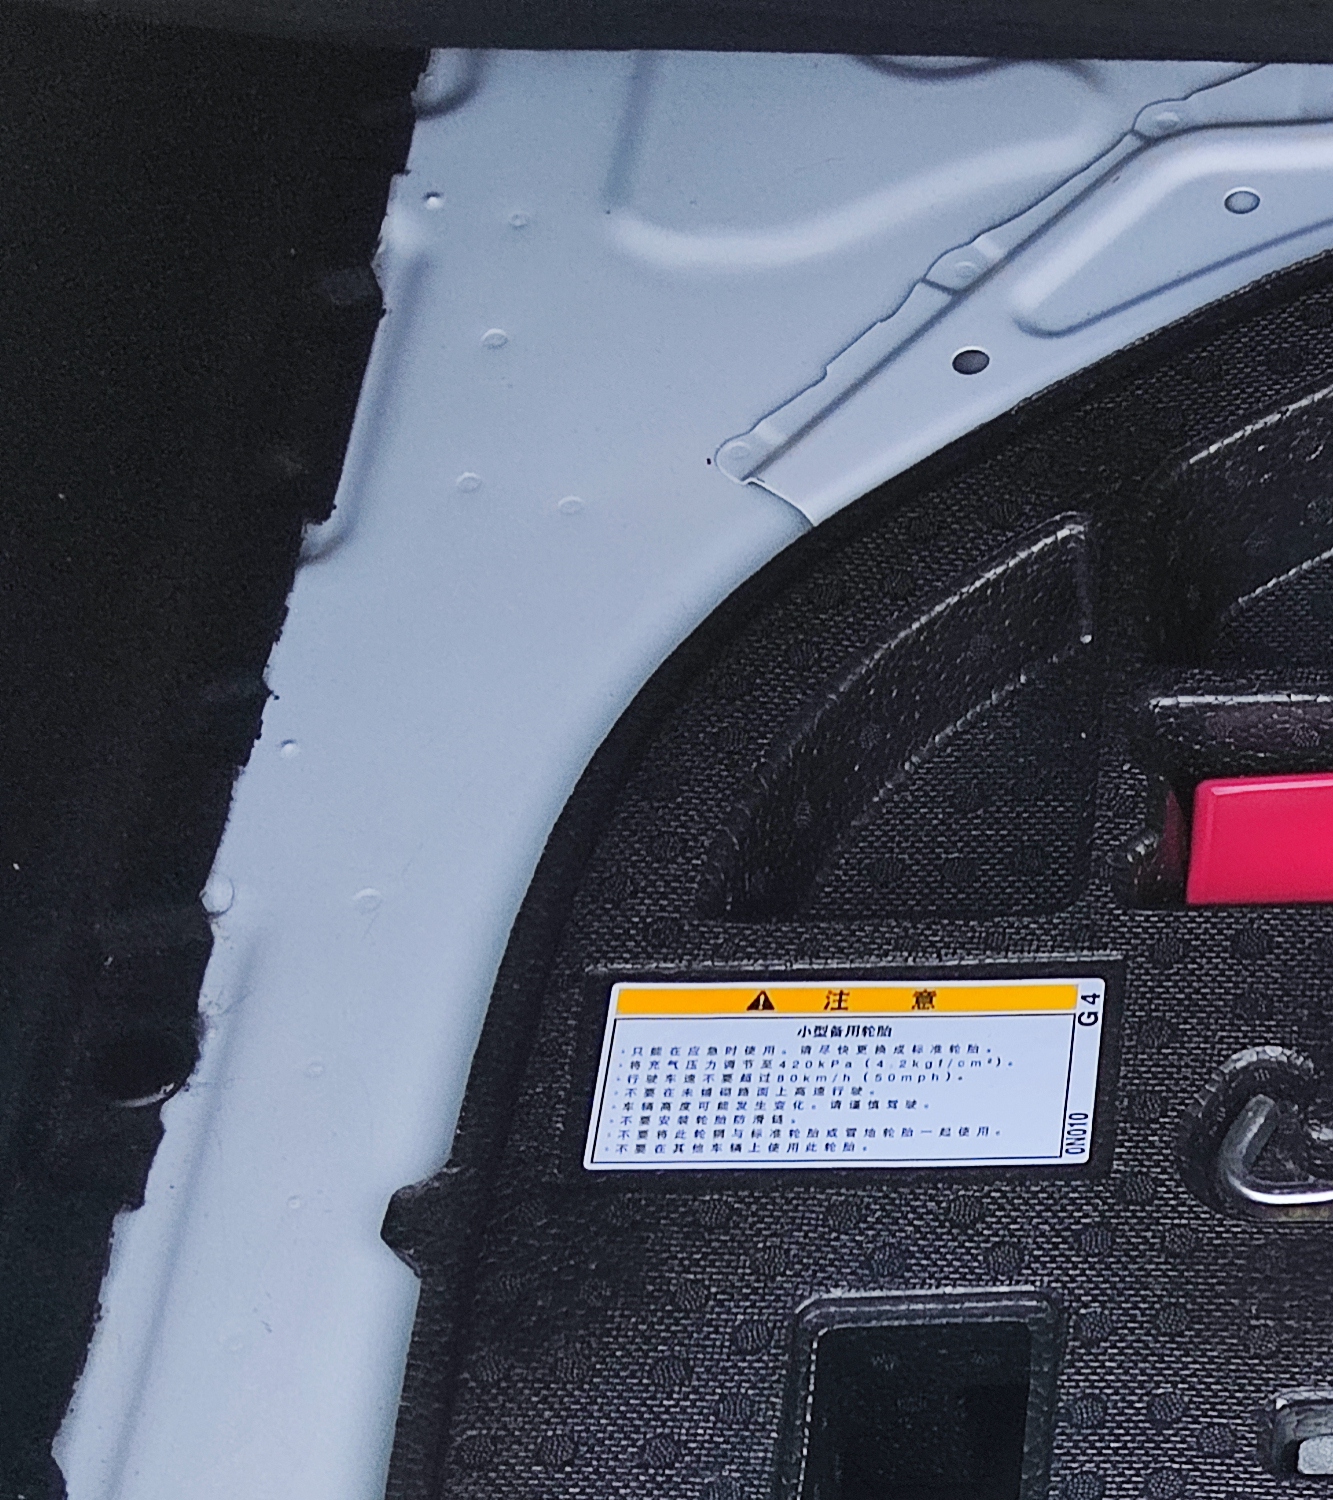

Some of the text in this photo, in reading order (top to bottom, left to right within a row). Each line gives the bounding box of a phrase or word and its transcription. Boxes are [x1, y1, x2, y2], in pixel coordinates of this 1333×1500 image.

[824, 989, 937, 1011] 注意
[797, 1025, 893, 1038] 小型备用轮胎
